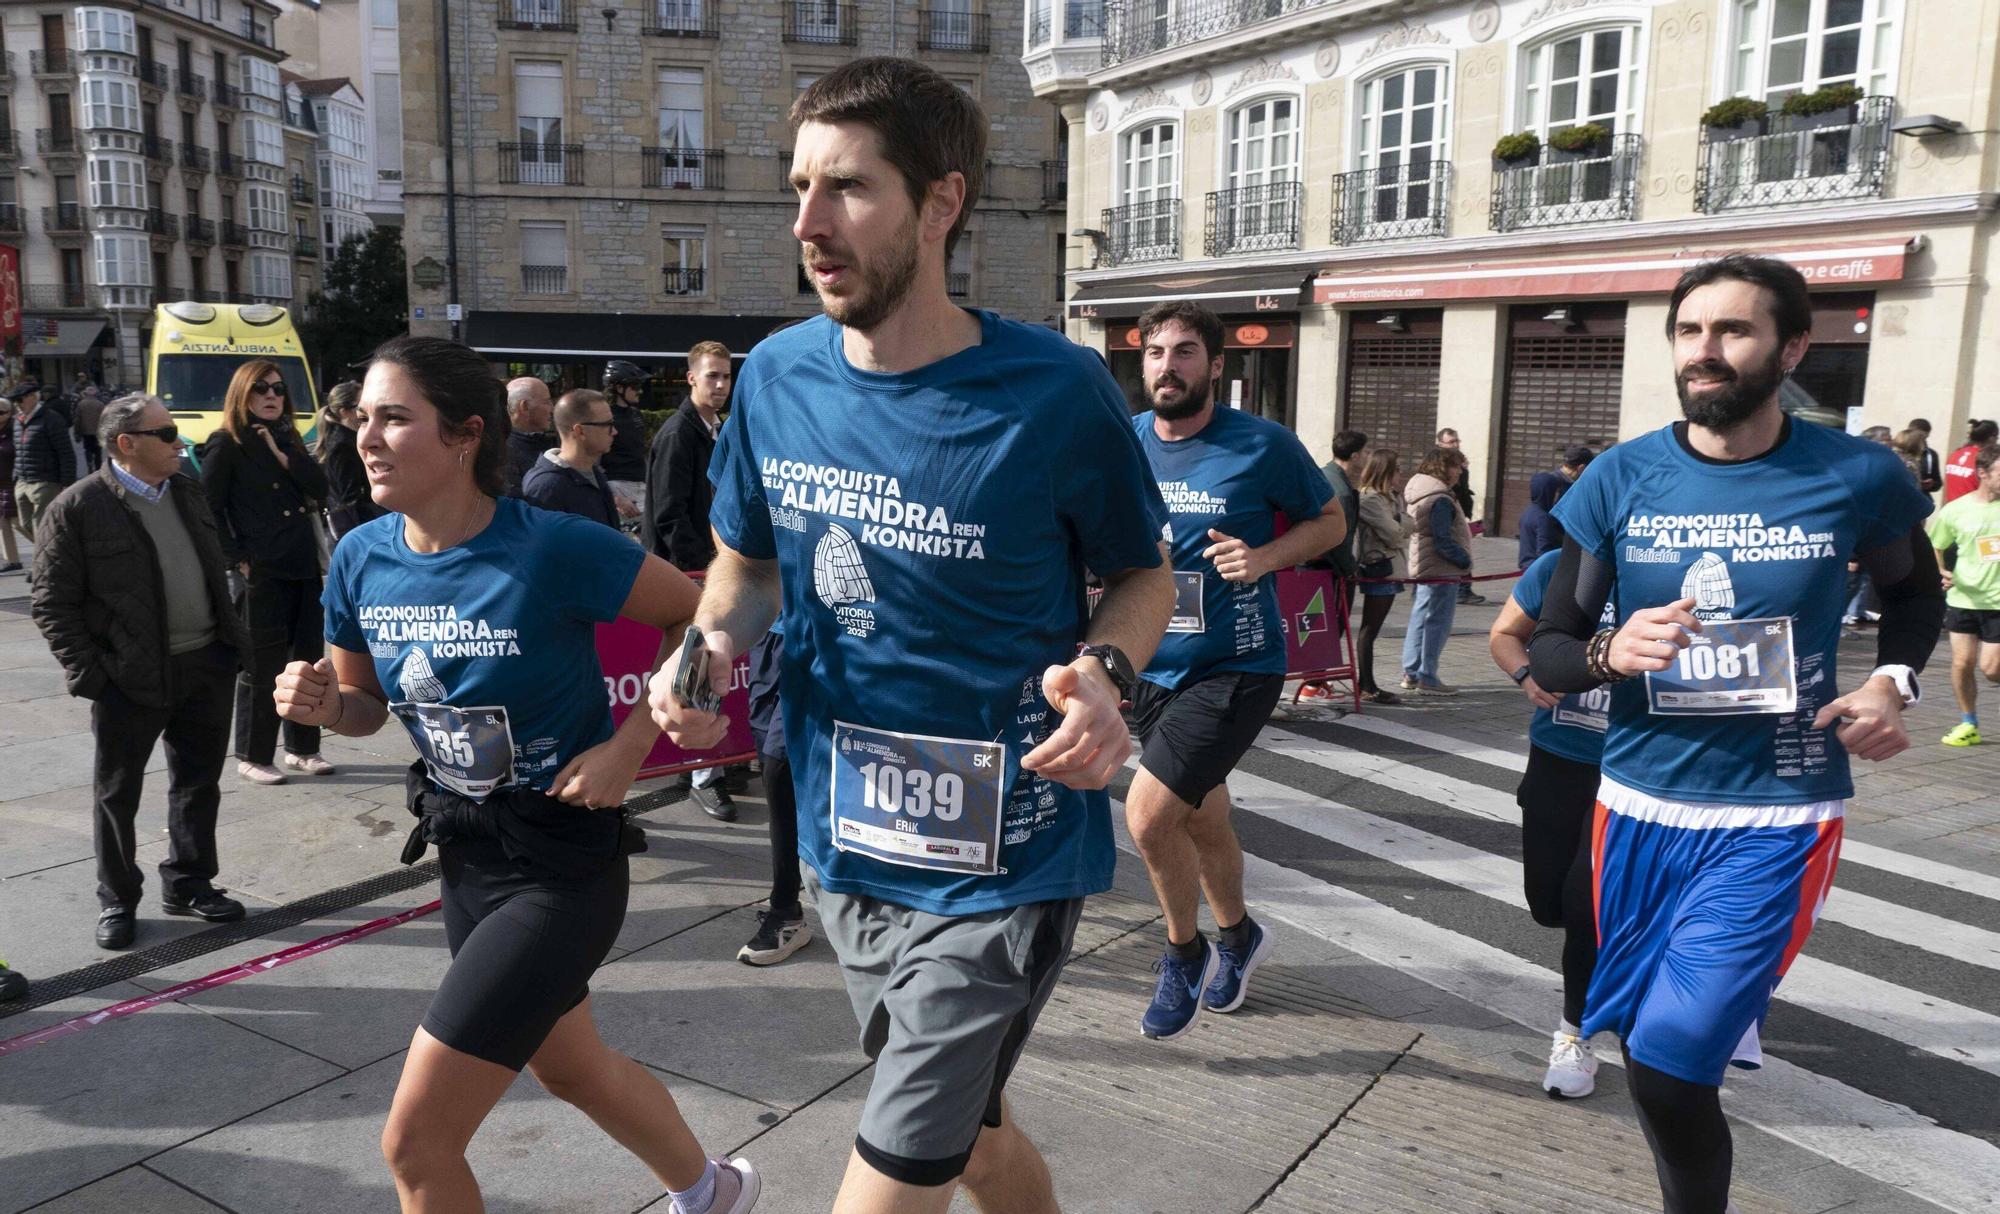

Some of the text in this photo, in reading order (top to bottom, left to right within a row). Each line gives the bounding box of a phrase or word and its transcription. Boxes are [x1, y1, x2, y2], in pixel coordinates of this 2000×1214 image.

[1816, 265, 1828, 278] e
[1829, 259, 1874, 280] caffé
[762, 457, 902, 498] LA CONQUISTA
[762, 476, 785, 490] DE LA
[1157, 481, 1189, 492] UISTA
[1161, 490, 1227, 505] ENDRA REN
[781, 482, 986, 538] ALMENDRA REN
[1169, 503, 1227, 515] KONKISTA
[1628, 513, 1764, 531] LA CONQUISTA
[1627, 528, 1657, 536] DE LA
[1653, 525, 1834, 547] ALMENDRA REN
[860, 523, 985, 560] KONKISTA
[1636, 547, 1681, 563] Edición
[1732, 544, 1836, 562] KONKISTA
[359, 605, 457, 622] LA CONQUISTA
[833, 606, 875, 620] VITORIA
[370, 621, 379, 629] LA
[378, 619, 518, 641] ALMENDRA REN
[836, 616, 876, 630] GASTEIZ
[1764, 624, 1783, 636] 5K
[847, 626, 867, 638] 2025
[433, 641, 522, 658] KONKISTA
[1678, 643, 1761, 681] 1081
[1016, 711, 1048, 724] LABO
[972, 753, 993, 768] 5K
[859, 761, 964, 822] 1039
[895, 819, 919, 834] ERIK
